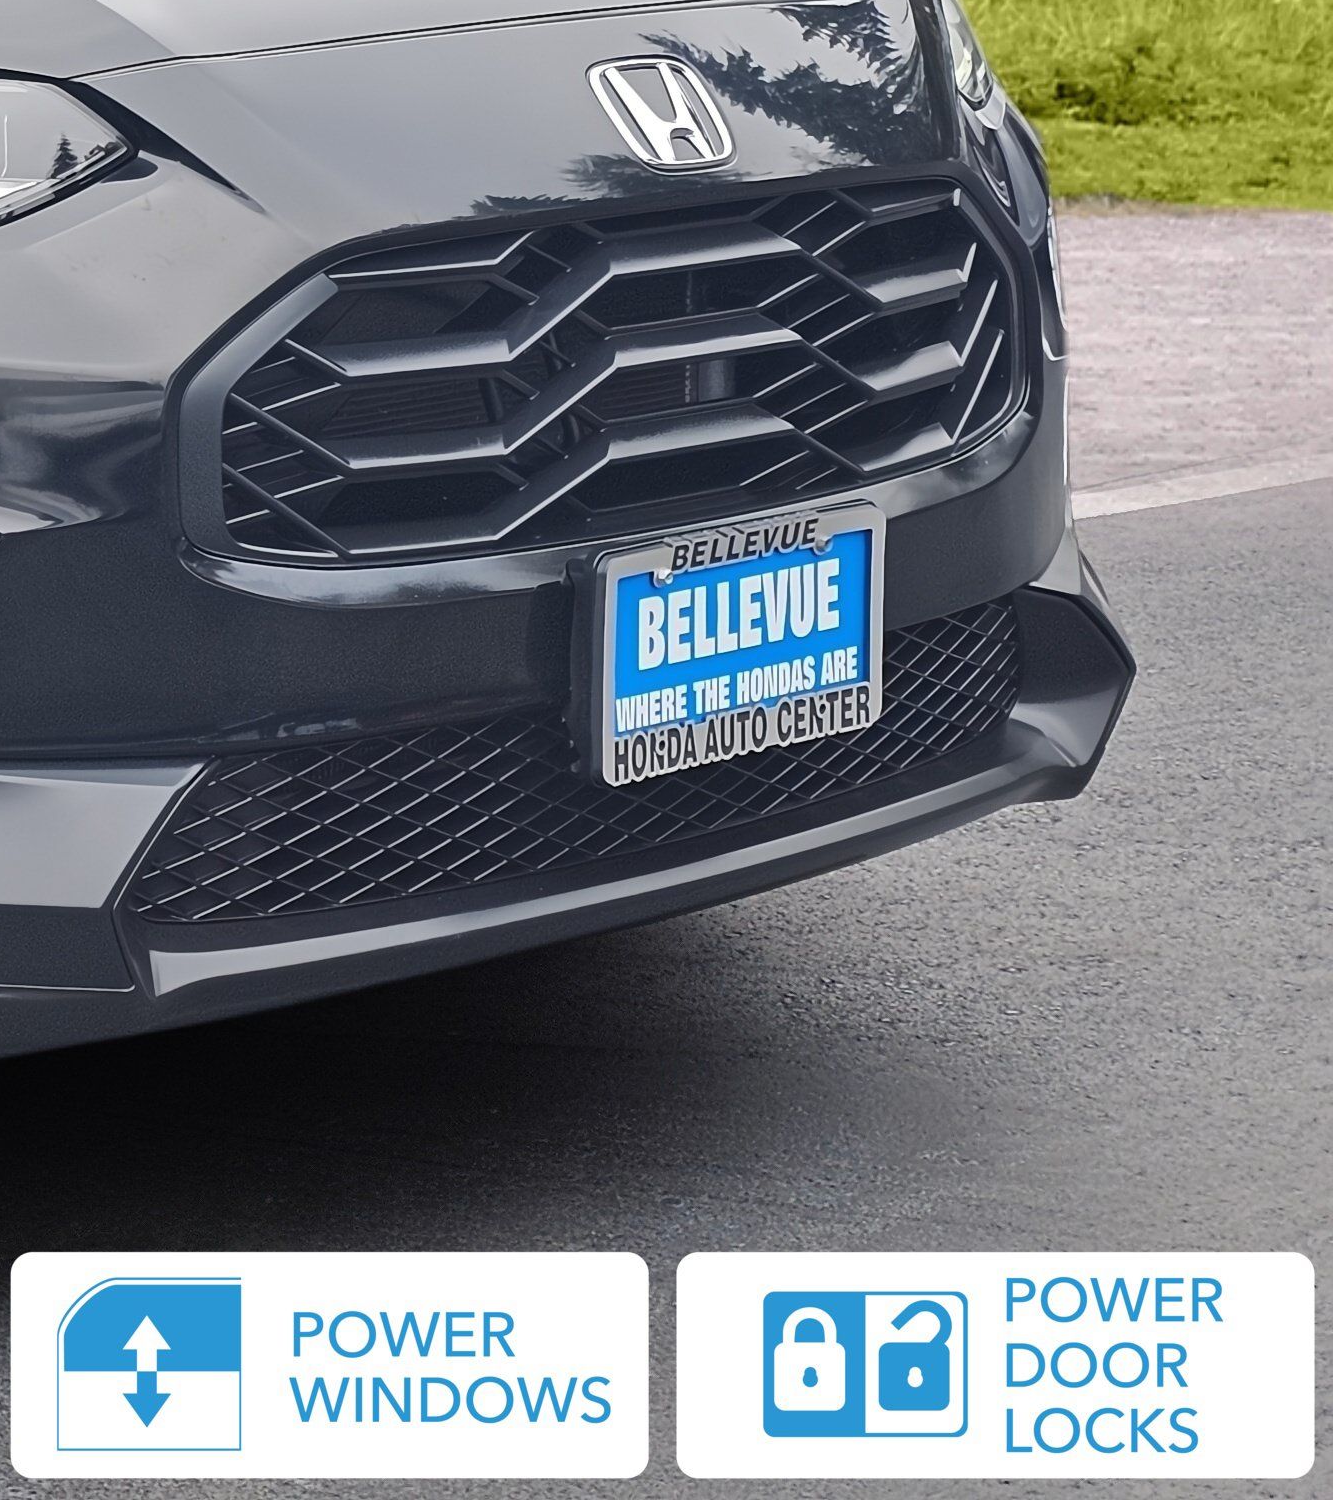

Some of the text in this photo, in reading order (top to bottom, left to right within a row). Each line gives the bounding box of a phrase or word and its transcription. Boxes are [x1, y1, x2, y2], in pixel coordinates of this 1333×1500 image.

[670, 517, 820, 572] BELLEVUE
[637, 557, 841, 671] BELLEVUE
[613, 687, 871, 783] HONDA AUTO CENTER
[615, 645, 859, 733] WHERE THE HONDAS ARE
